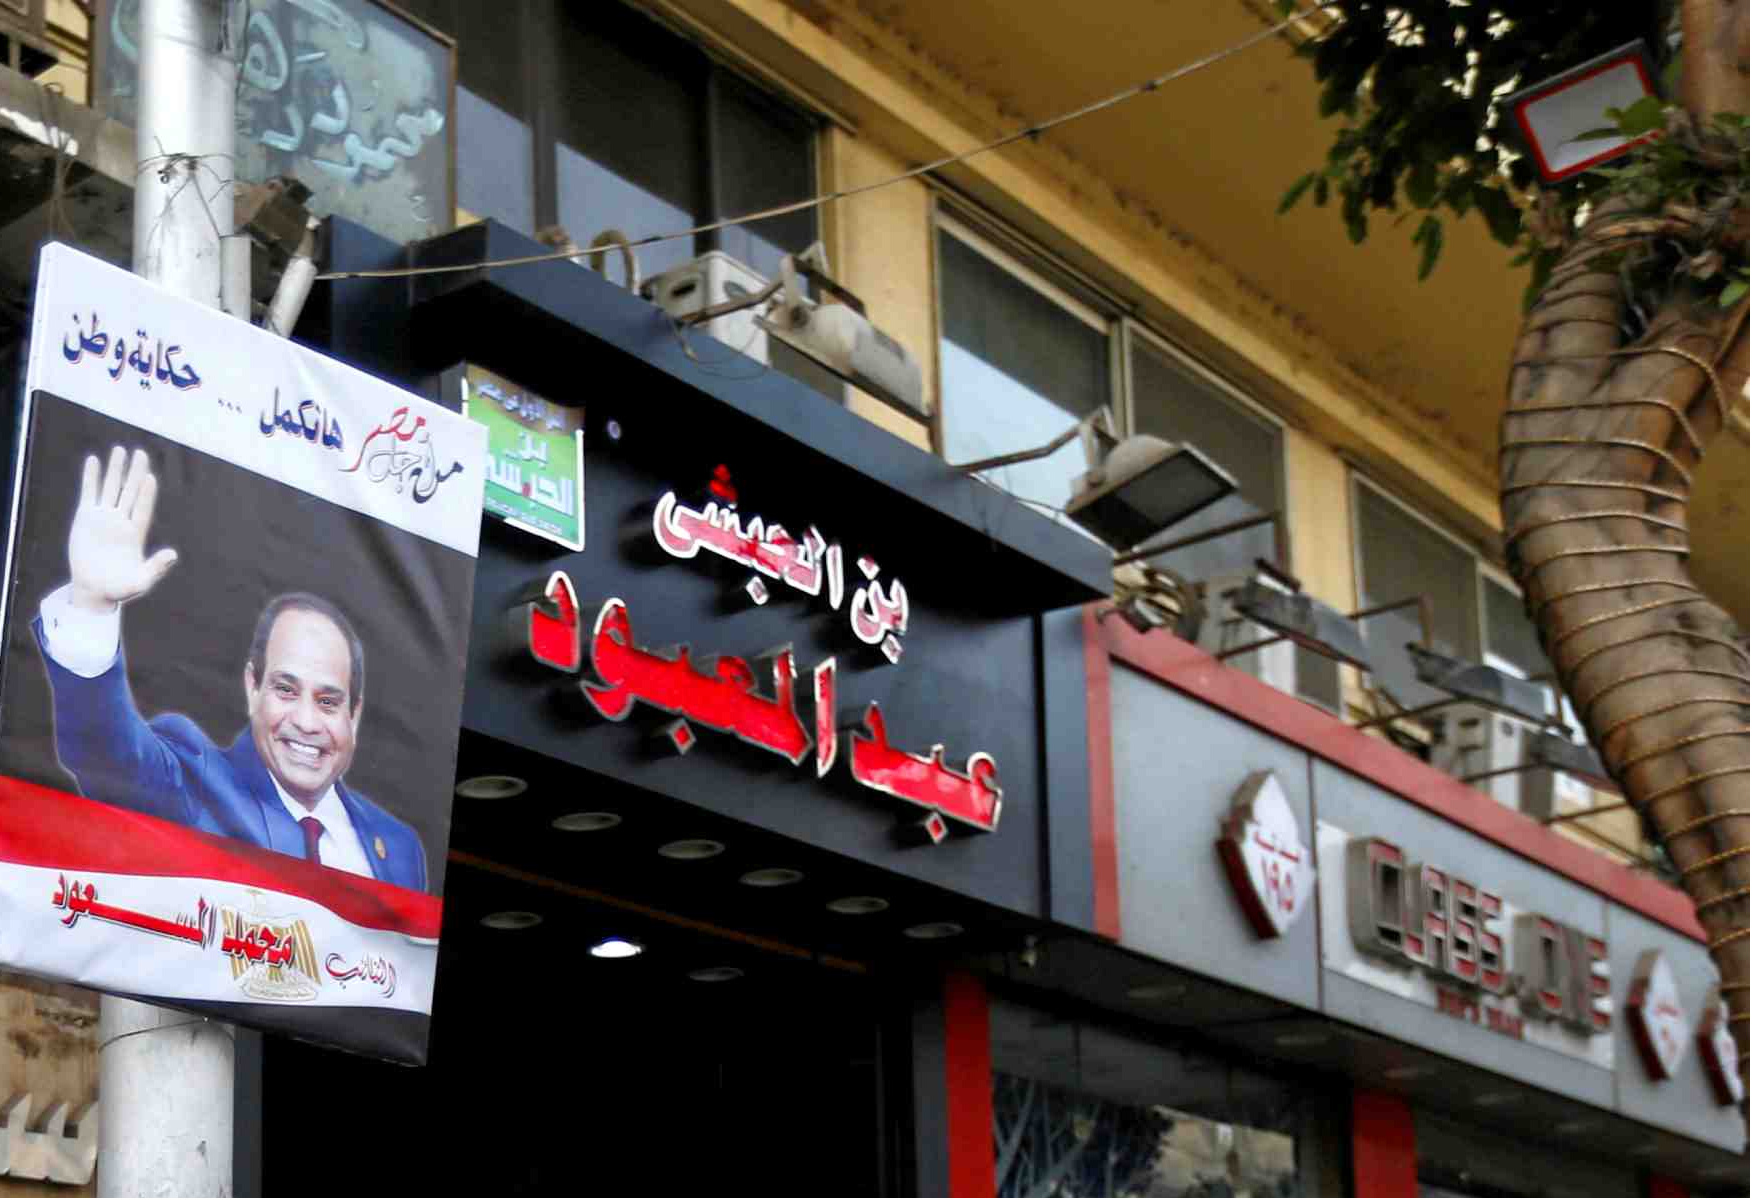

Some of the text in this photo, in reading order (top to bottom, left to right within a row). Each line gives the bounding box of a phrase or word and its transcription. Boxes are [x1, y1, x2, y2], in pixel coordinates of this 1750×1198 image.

[62, 312, 125, 382] وطن
[127, 328, 202, 391] حكاية
[849, 556, 911, 664] بن
[528, 571, 1003, 843] عبد المعبود
[220, 908, 296, 968] محمد
